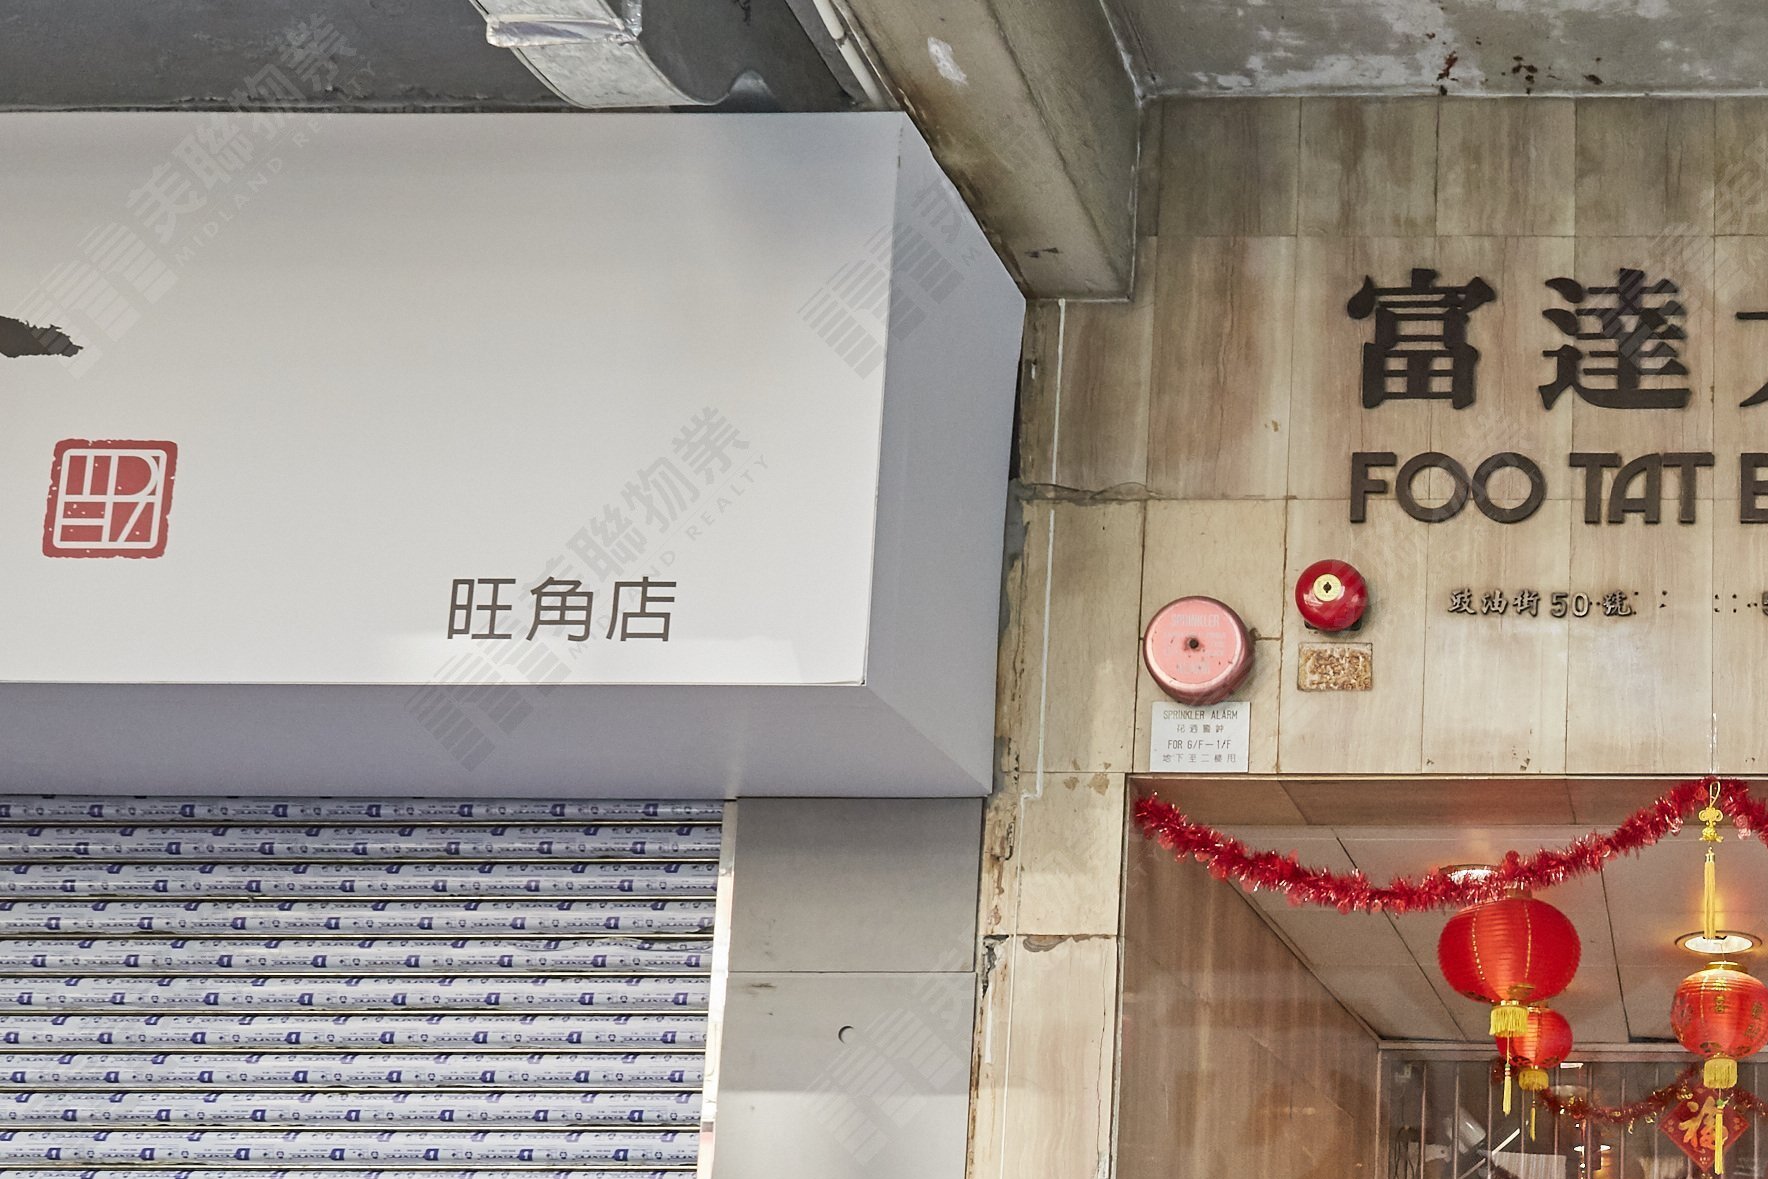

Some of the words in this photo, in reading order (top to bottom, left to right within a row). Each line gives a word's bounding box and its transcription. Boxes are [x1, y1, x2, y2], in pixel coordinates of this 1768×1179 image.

[1349, 451, 1547, 524] FOO
[1570, 451, 1714, 525] TAT
[446, 576, 677, 642] 旺角店
[1163, 710, 1205, 721] SPRINKLER
[1211, 709, 1238, 720] ALARM
[1168, 740, 1182, 750] FOR
